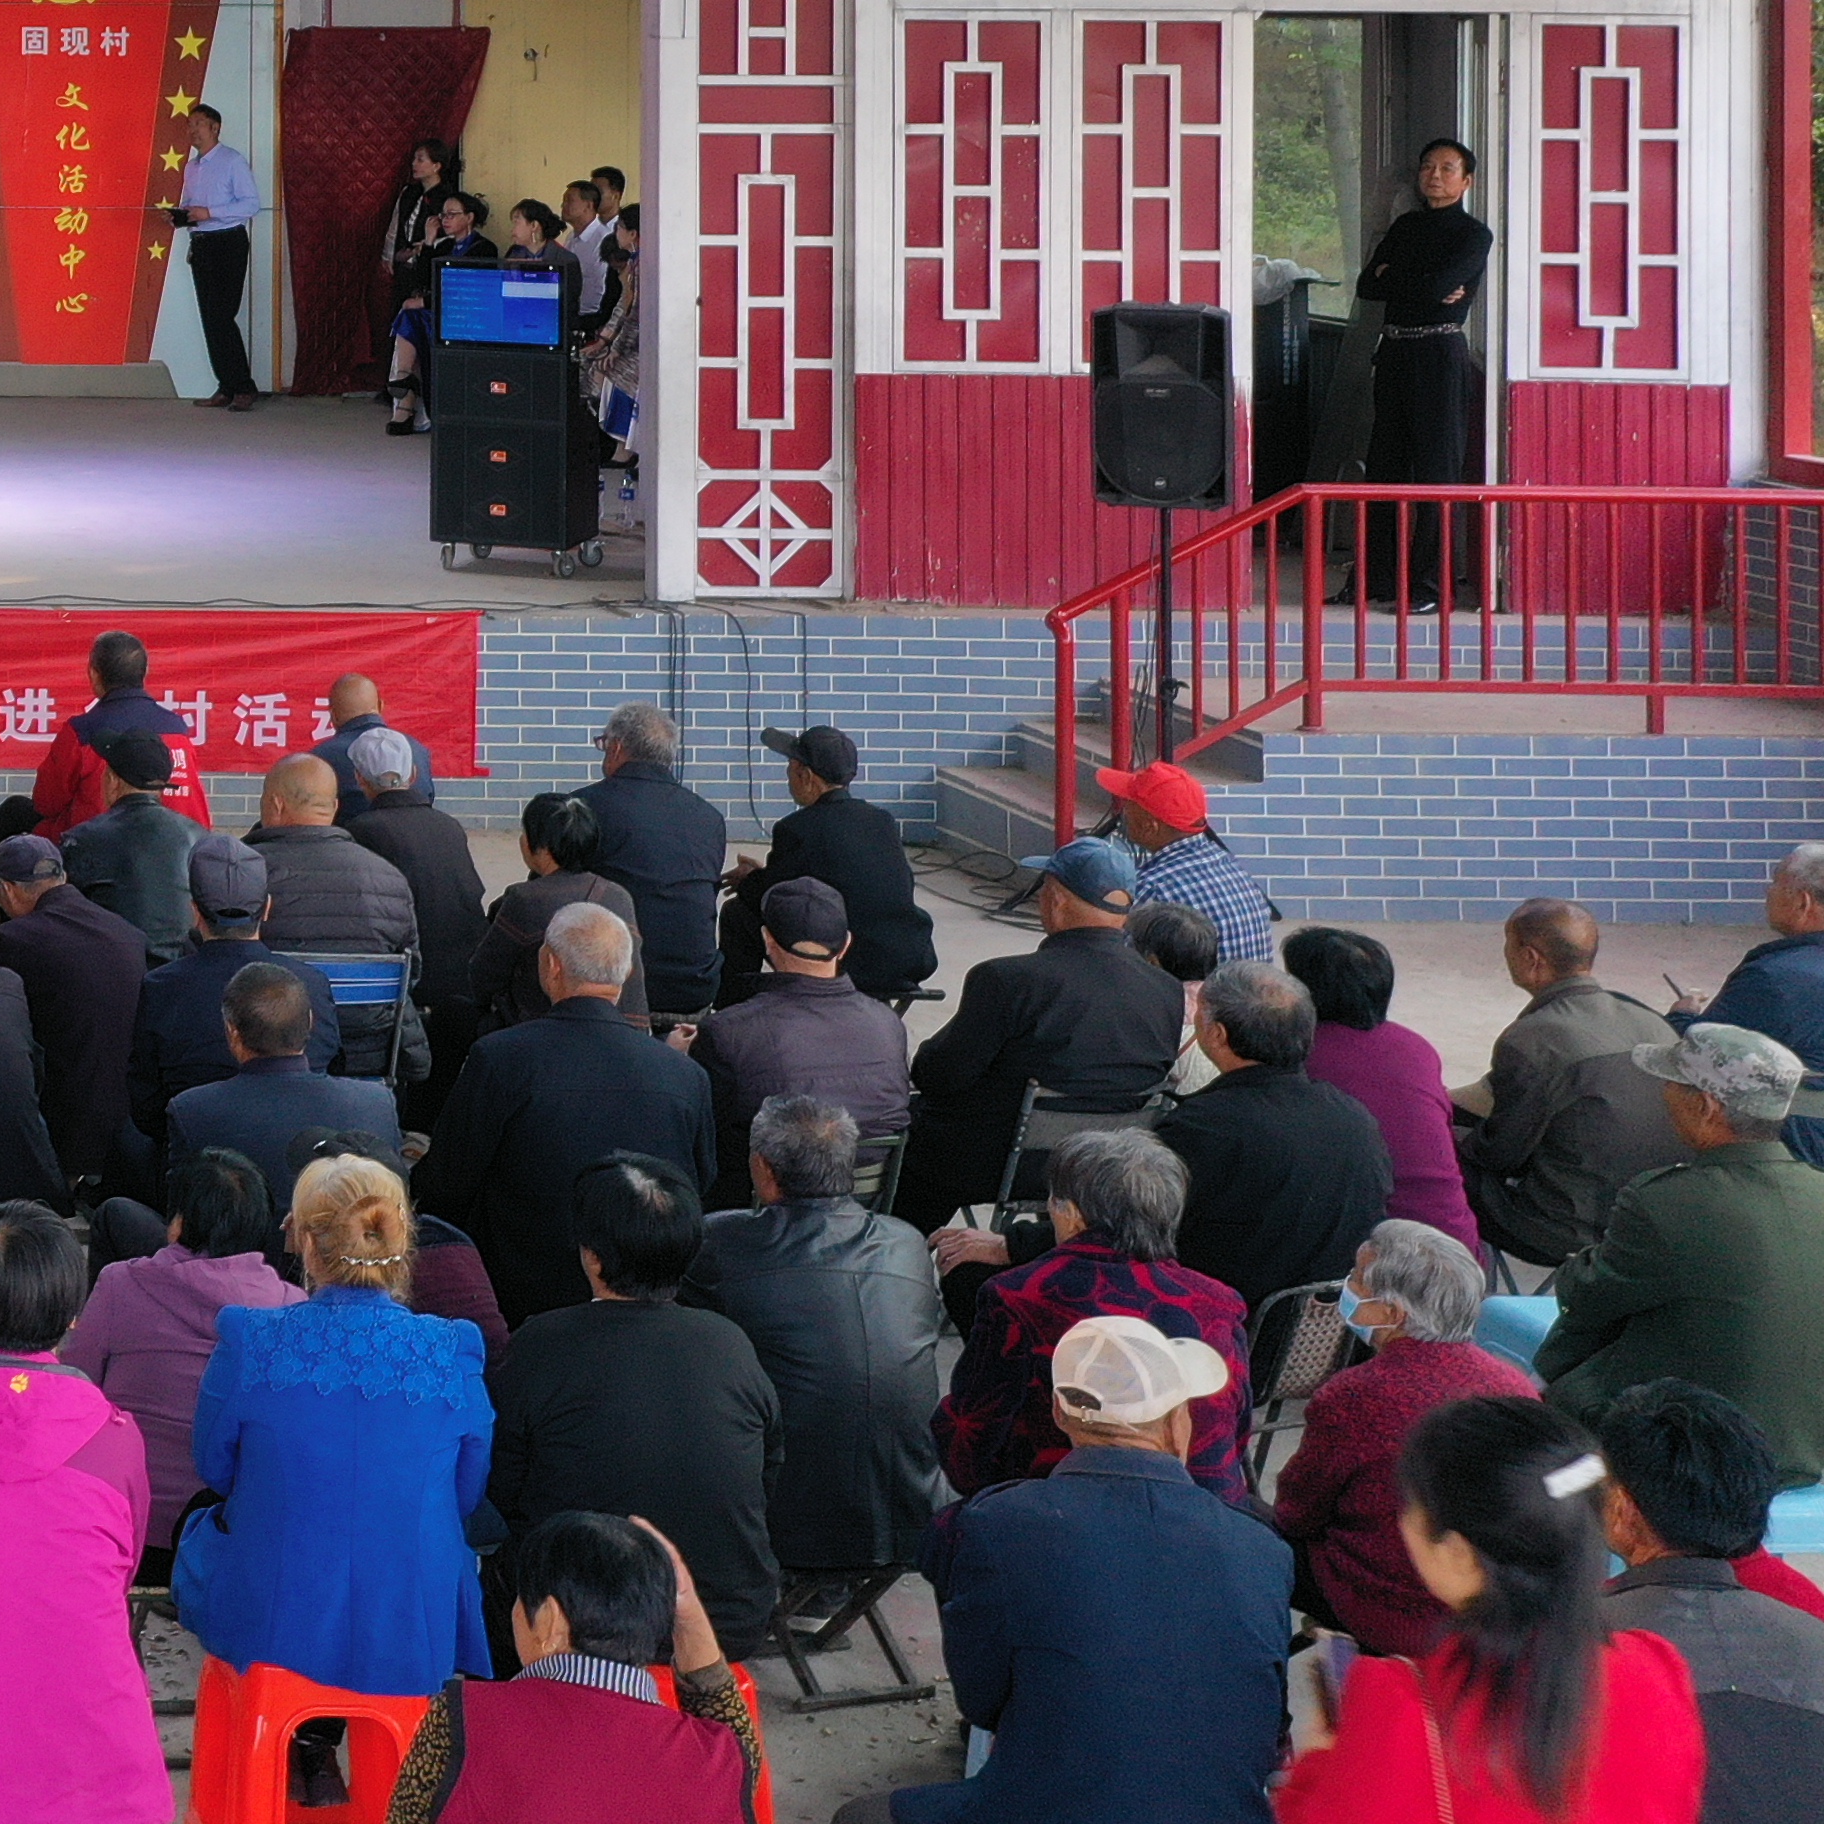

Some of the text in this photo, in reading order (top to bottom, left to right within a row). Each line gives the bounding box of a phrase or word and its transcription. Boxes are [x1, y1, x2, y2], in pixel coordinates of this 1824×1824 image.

[21, 26, 130, 56] 固现村
[54, 82, 90, 314] 文化活动中心
